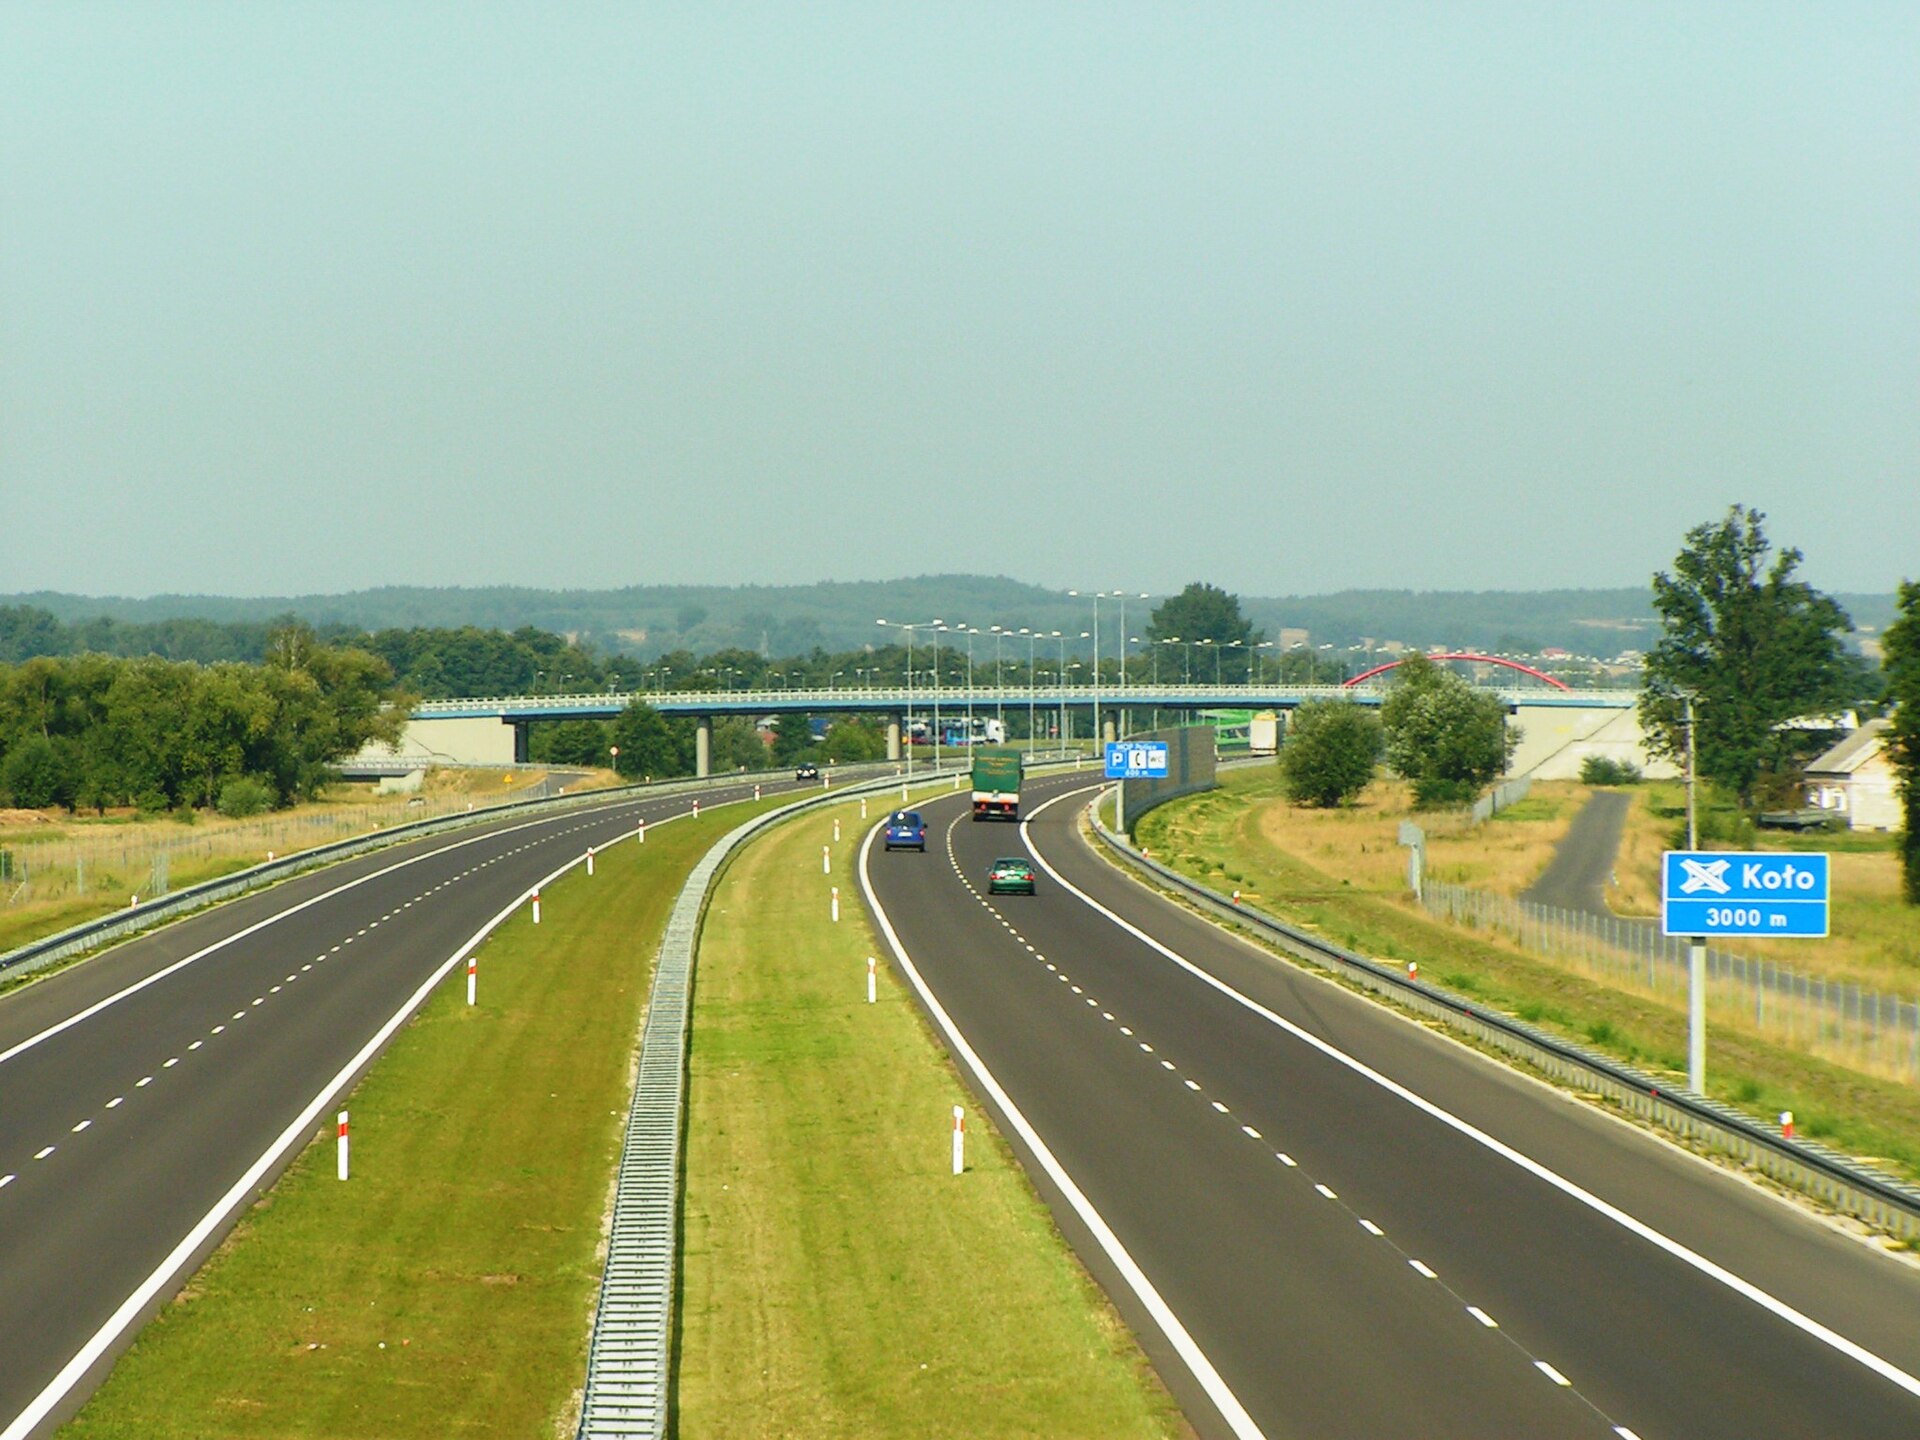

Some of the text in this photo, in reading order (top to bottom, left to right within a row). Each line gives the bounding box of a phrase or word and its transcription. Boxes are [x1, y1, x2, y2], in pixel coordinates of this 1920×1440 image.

[1112, 752, 1123, 767] P
[1742, 863, 1815, 890] Koło
[1706, 907, 1788, 927] 3000 m
